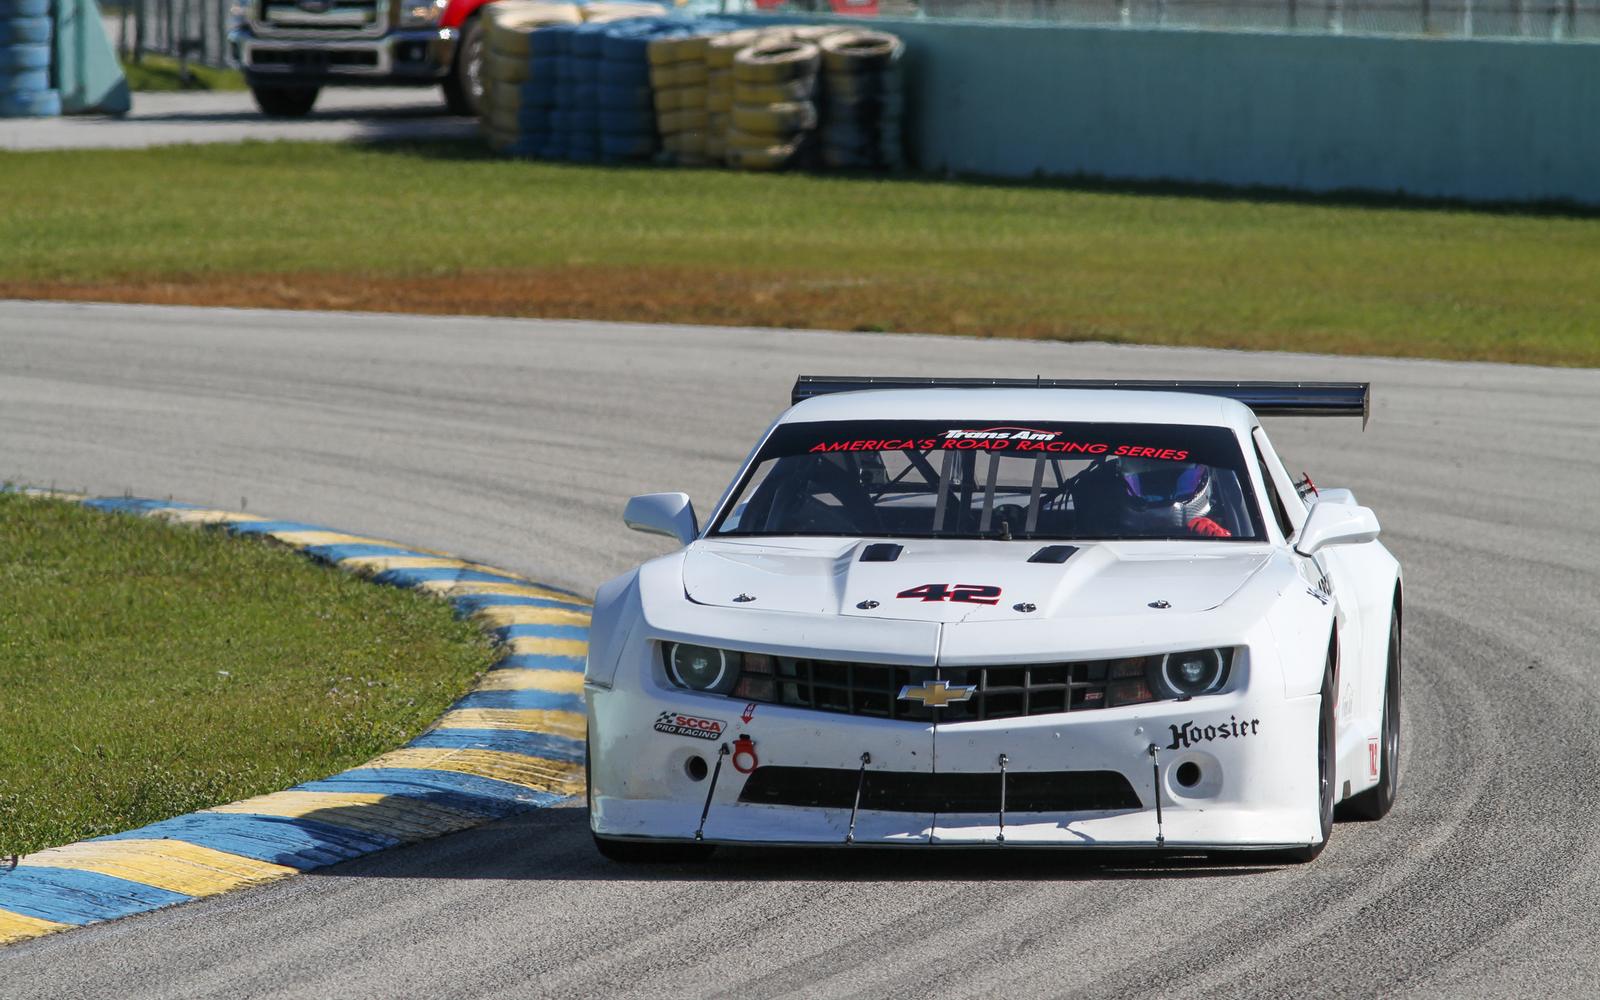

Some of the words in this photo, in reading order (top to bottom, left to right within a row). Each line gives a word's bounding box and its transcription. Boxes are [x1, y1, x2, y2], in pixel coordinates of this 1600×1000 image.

[945, 429, 1008, 439] Trans
[1009, 430, 1056, 441] Am
[809, 439, 936, 453] AMERICA'S
[942, 438, 1009, 449] ROAD
[1016, 440, 1109, 454] RACING
[1114, 445, 1188, 461] SERIES
[896, 584, 1002, 606] 42
[655, 723, 676, 732] PRO
[678, 727, 719, 739] RACING
[675, 716, 721, 732] SCCA
[1166, 715, 1260, 750] Hoosier
